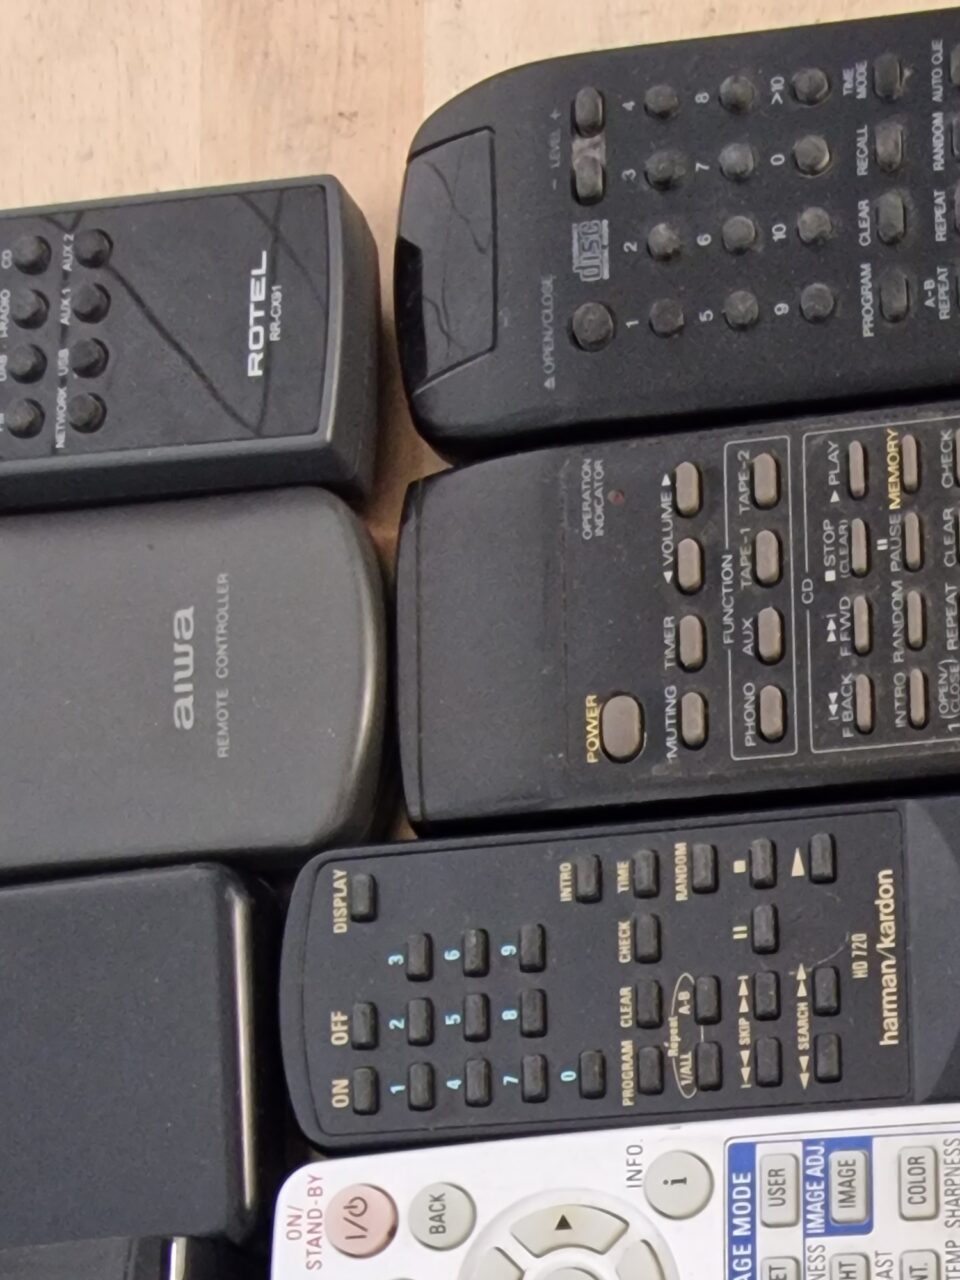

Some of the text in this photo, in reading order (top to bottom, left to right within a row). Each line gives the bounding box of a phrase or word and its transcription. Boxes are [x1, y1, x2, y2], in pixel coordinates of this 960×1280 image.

[856, 125, 868, 175] RECALL
[932, 112, 944, 171] RANDOM
[858, 200, 871, 246] CLEAR
[934, 190, 946, 241] REPEAT
[63, 245, 73, 271] AUX
[248, 251, 266, 376] ROTEL
[542, 275, 555, 374] OPEN/CLOSE
[860, 263, 874, 337] PROGRAM
[58, 349, 69, 376] USB
[56, 387, 67, 448] NETWORK
[738, 450, 750, 514] TAPE-2
[828, 441, 840, 485] PLAY
[887, 429, 900, 509] MEMORY
[940, 429, 953, 488] CHECK
[582, 459, 592, 539] OPERATION
[593, 460, 604, 536] INDICATOR
[661, 493, 673, 566] VOLUME
[740, 528, 752, 589] TAPE-1
[721, 555, 734, 644] FUNCTION
[802, 579, 813, 604] CD
[945, 583, 958, 650] REPEAT
[174, 606, 194, 729] aiwa
[216, 573, 229, 757] REMOTE CONTROLLER
[586, 694, 598, 763] POWER
[665, 686, 678, 757] MUTING
[743, 682, 756, 746] PHONO
[333, 870, 347, 933] DISPLAY
[617, 862, 629, 893] TIME
[675, 842, 687, 901] RANDOM
[618, 921, 631, 963] CHECK
[851, 934, 868, 978] HD 720
[875, 870, 898, 1045] harman/kardon
[331, 1012, 348, 1045] OFF
[445, 1014, 460, 1024] 5
[739, 1018, 750, 1045] SKIP
[797, 1002, 809, 1050] SEARCH
[332, 1079, 349, 1107] ON
[621, 1040, 633, 1106] PROGRAM
[732, 1173, 751, 1236] MODE
[838, 1160, 856, 1208] IMAGE
[908, 1156, 926, 1204] COLOR
[286, 1206, 302, 1240] ON/
[306, 1175, 323, 1270] STAND-BY
[429, 1194, 446, 1234] BACK
